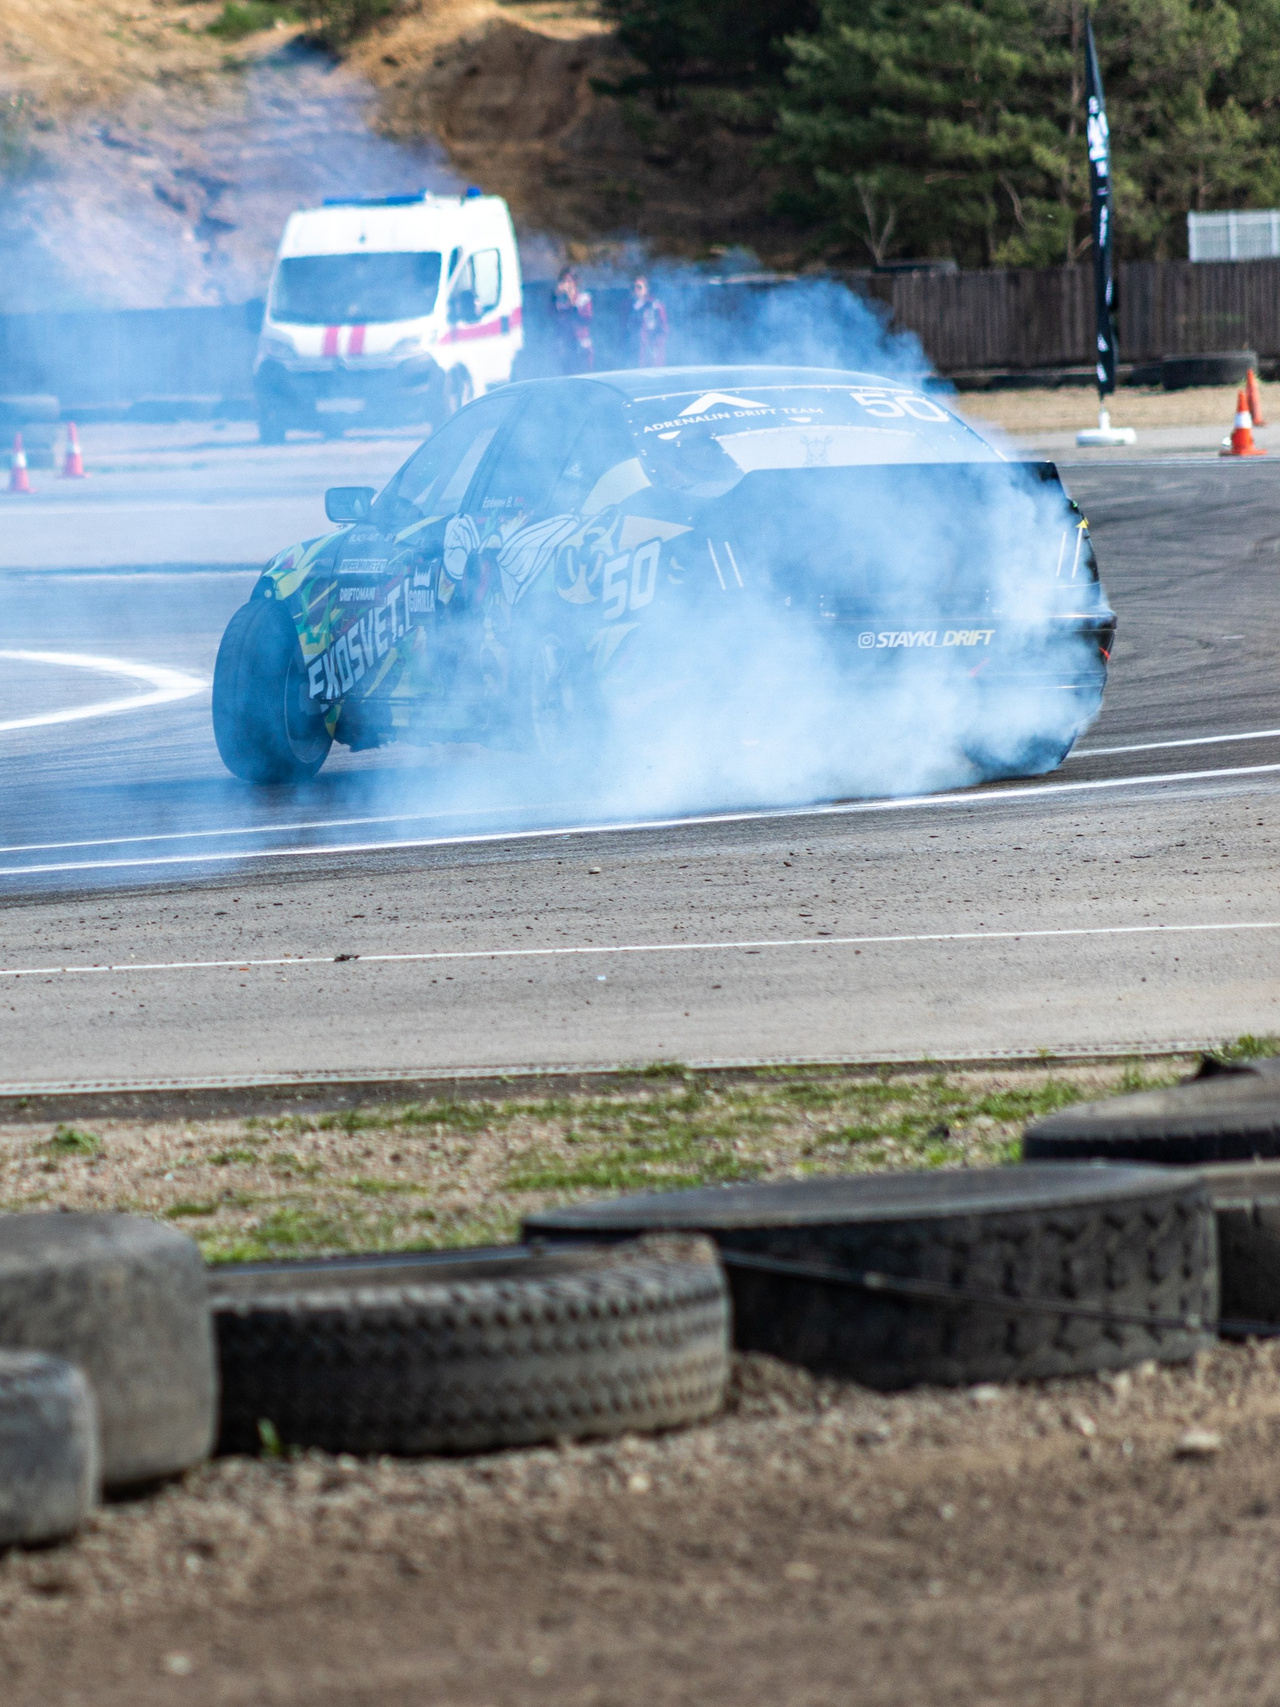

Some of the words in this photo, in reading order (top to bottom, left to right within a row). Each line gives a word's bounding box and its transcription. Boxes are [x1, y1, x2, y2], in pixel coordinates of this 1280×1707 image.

[643, 411, 731, 434] ADRENALIN
[733, 408, 777, 419] DRIFT
[780, 406, 824, 415] TEAM
[850, 392, 950, 422] 50
[601, 540, 661, 620] 50
[408, 589, 435, 613] GORILLA
